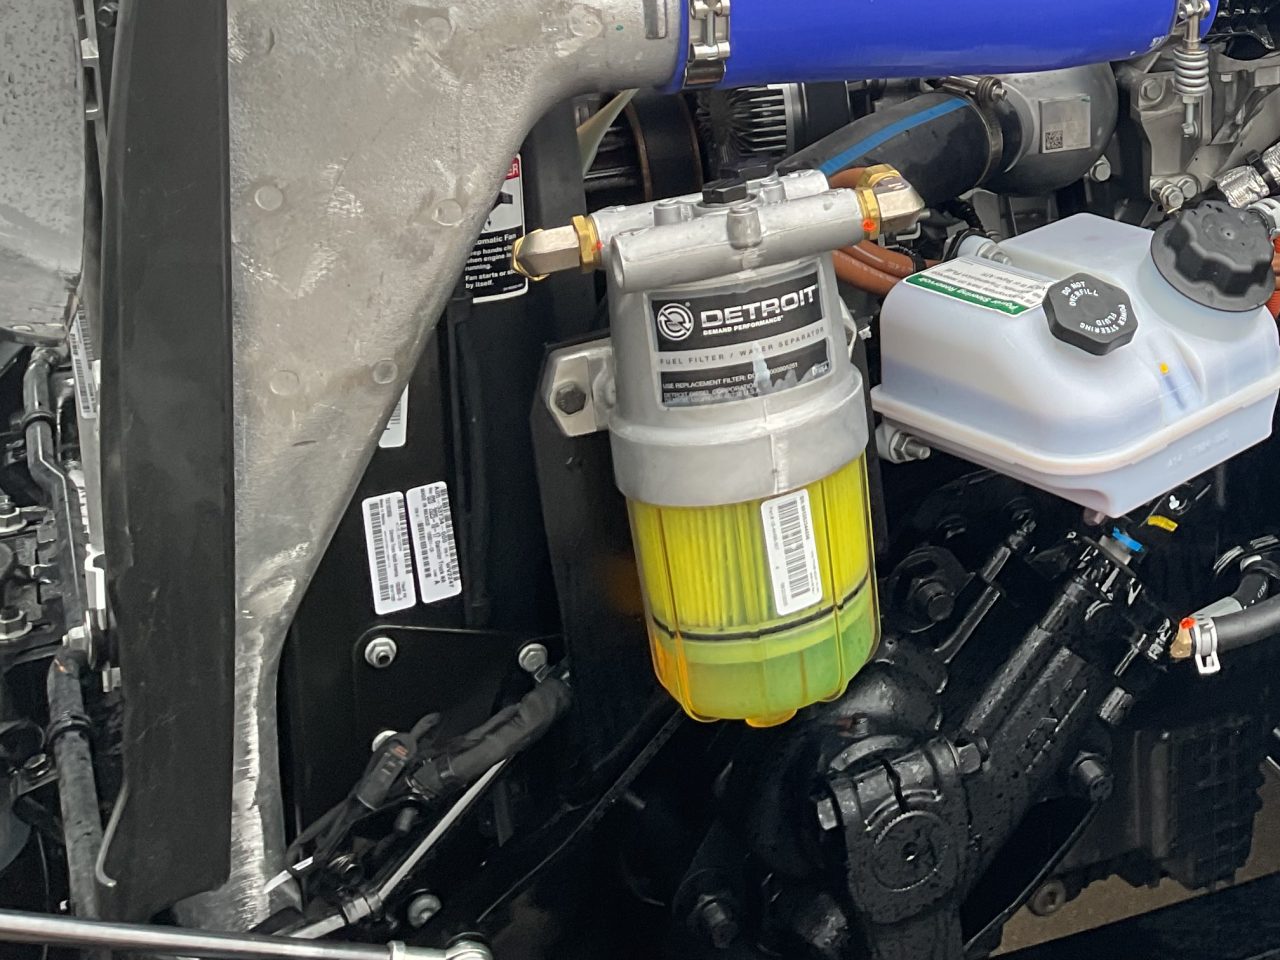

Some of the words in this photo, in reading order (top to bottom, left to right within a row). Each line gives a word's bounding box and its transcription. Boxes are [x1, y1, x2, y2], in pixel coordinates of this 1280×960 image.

[474, 235, 503, 246] omatic
[484, 253, 505, 262] engine
[465, 263, 493, 271] running.
[917, 277, 957, 292] Reservoir
[1062, 287, 1071, 296] DO
[1071, 281, 1086, 290] NOT
[957, 289, 992, 303] Steering
[1069, 288, 1099, 307] OVERFILL
[701, 284, 816, 328] DETROIT
[992, 299, 1019, 311] Power
[1095, 313, 1117, 326] FLUID
[1117, 304, 1126, 325] POWER
[703, 326, 732, 336] DEMAND
[733, 315, 783, 333] PERFORMANCE
[1080, 322, 1119, 334] STEERING
[659, 357, 683, 365] FUEL
[688, 353, 724, 364] FILTER
[778, 326, 825, 348] SEPARATOR
[675, 378, 721, 388] REPLACEMENT
[722, 374, 746, 384] FILTER:
